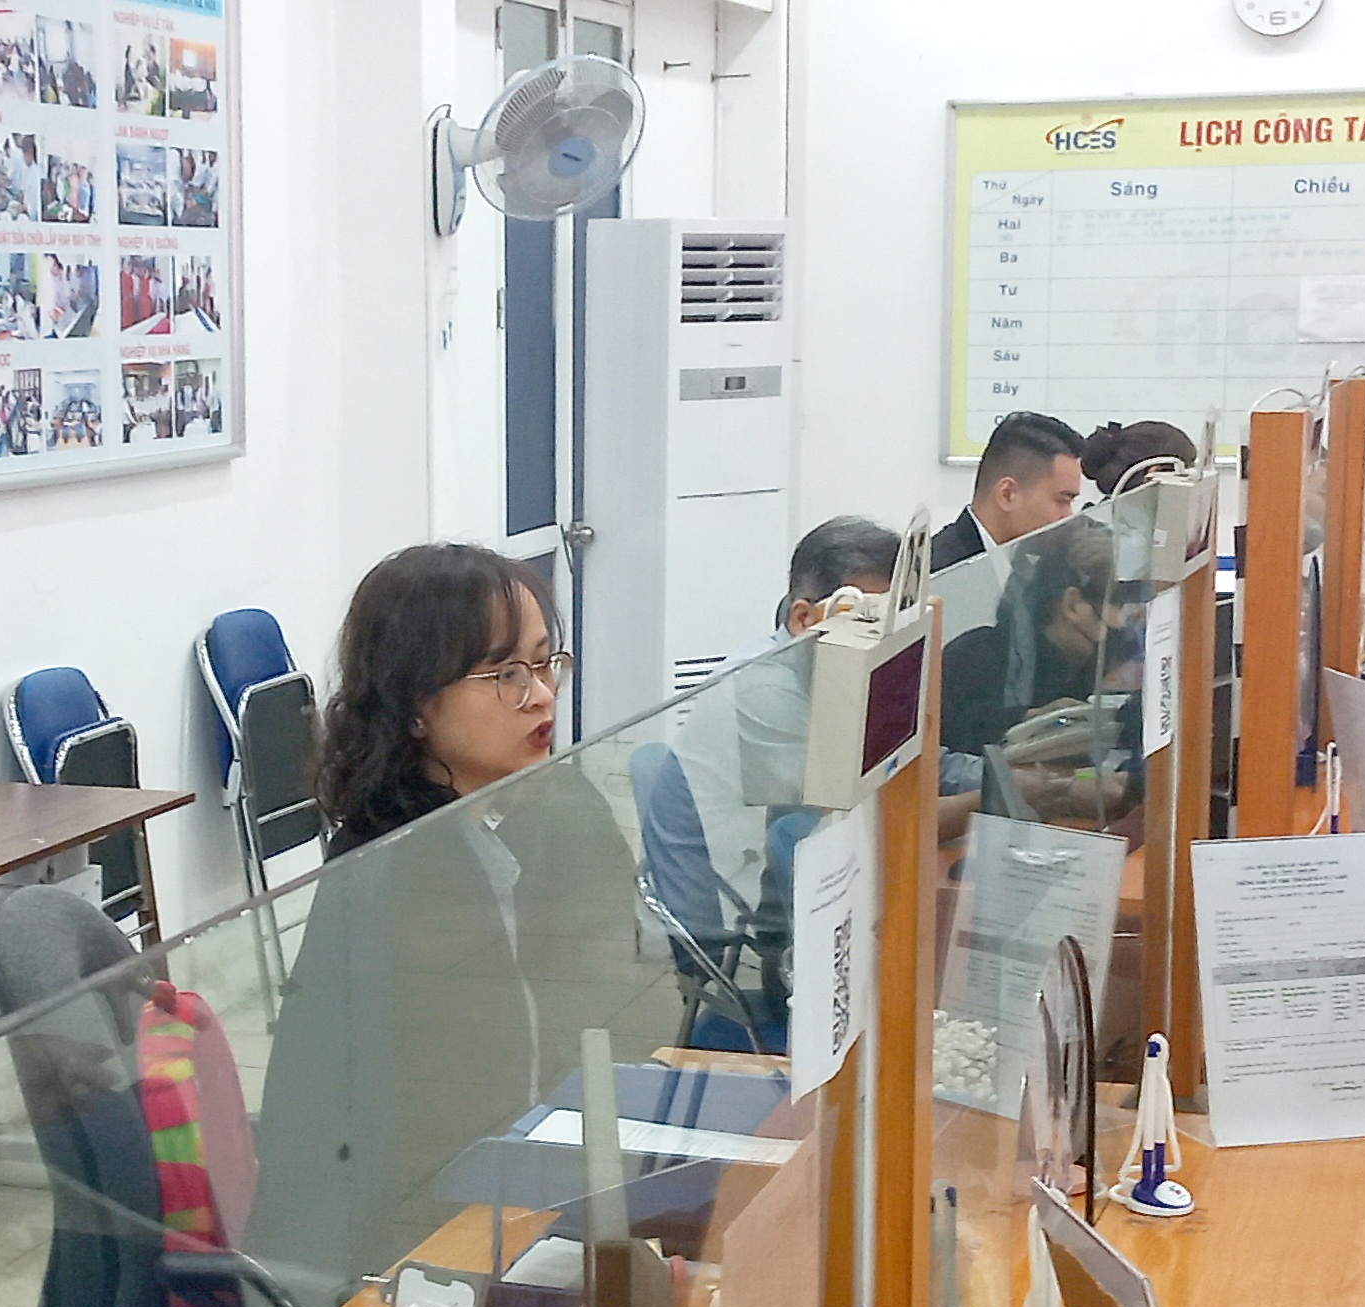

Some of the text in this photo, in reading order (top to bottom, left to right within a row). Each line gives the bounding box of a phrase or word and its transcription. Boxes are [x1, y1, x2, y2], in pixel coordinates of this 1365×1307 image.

[1269, 11, 1286, 25] 6
[1180, 119, 1242, 152] LỊCH
[1254, 112, 1333, 144] CÔNG
[1054, 130, 1117, 150] HCES
[1110, 181, 1158, 199] Sáng
[998, 218, 1021, 230] Hai
[1000, 252, 1018, 263] Ba
[999, 284, 1018, 296] Tư
[991, 317, 1023, 329] Năm
[993, 350, 1020, 362] Sáu
